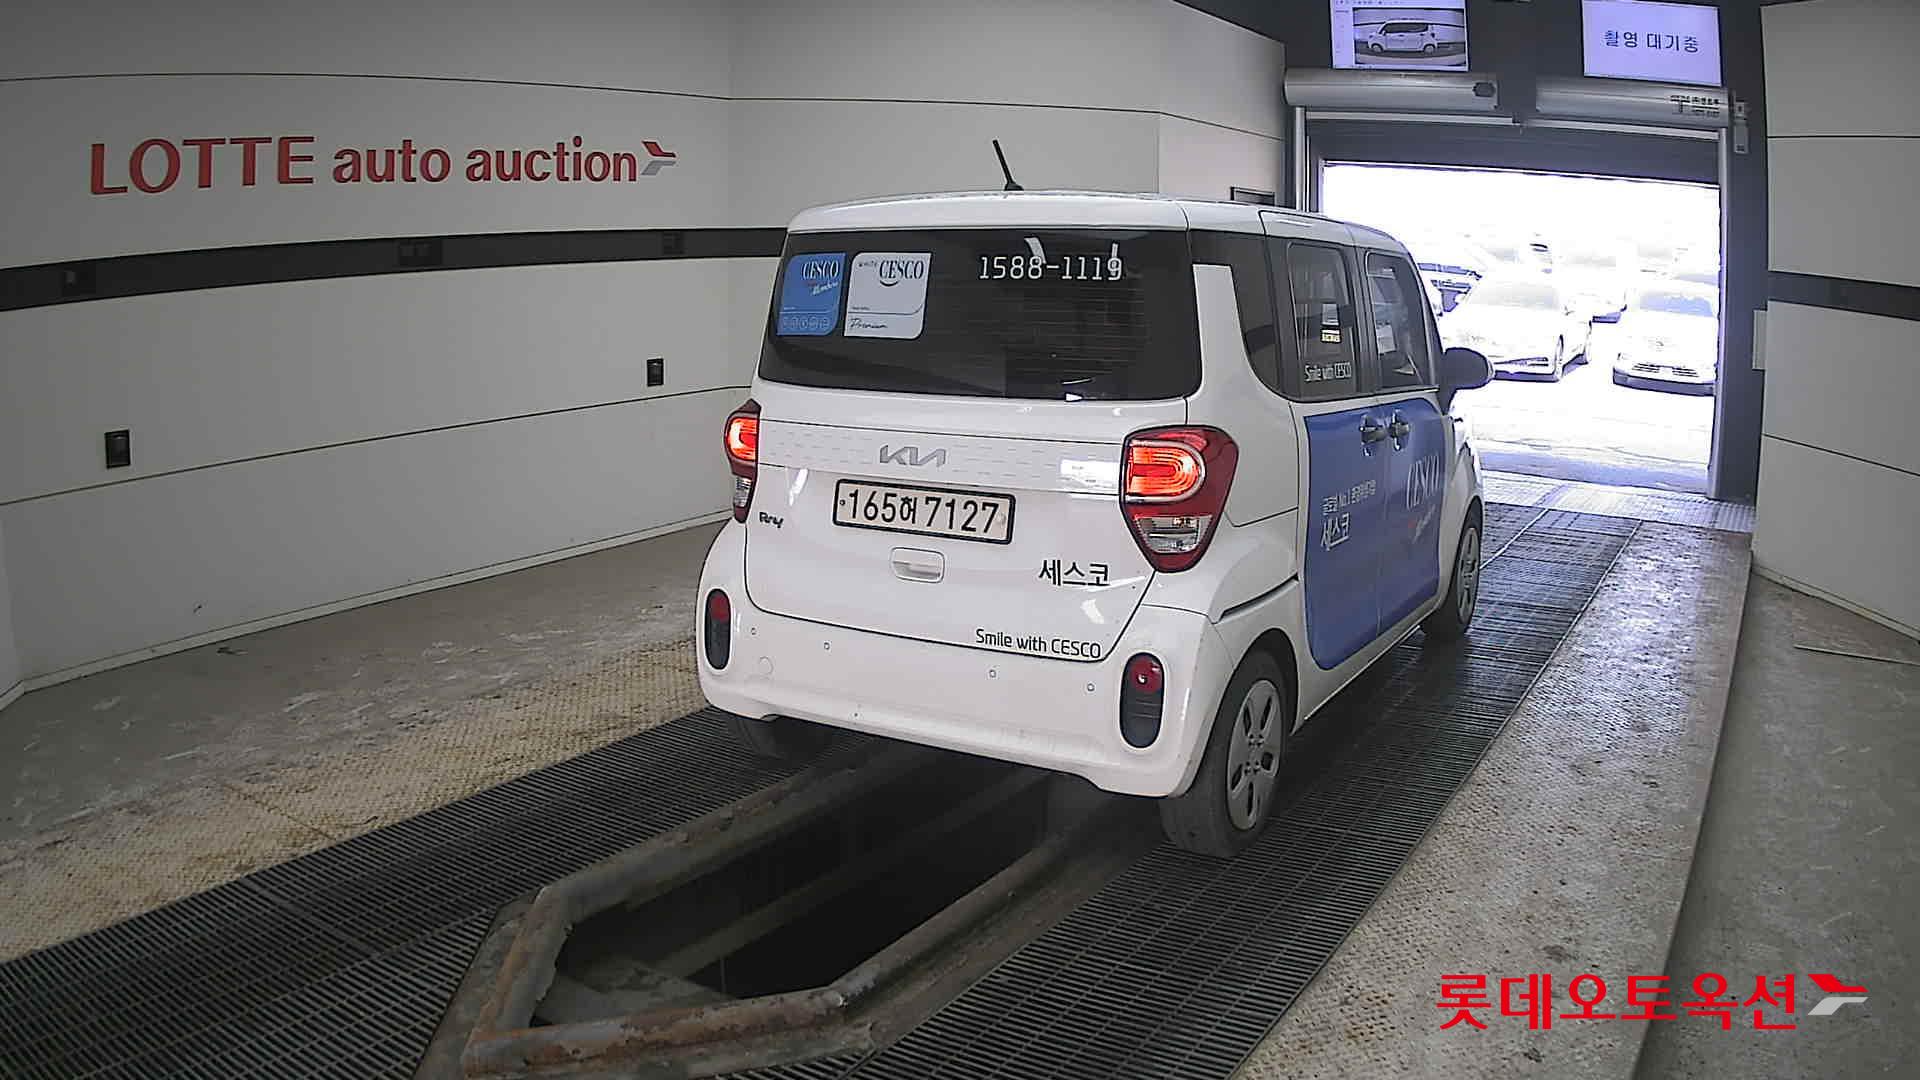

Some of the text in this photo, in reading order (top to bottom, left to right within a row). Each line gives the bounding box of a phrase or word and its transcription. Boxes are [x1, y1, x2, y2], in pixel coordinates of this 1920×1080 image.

[89, 135, 639, 195] LOTTE auto auction
[802, 259, 840, 281] CESCO
[879, 260, 925, 280] CESCO
[979, 255, 1123, 281] 1588-1119
[758, 511, 785, 529] Ray
[1038, 559, 1111, 587] 세스코
[975, 627, 1102, 659] Smile with CESCO
